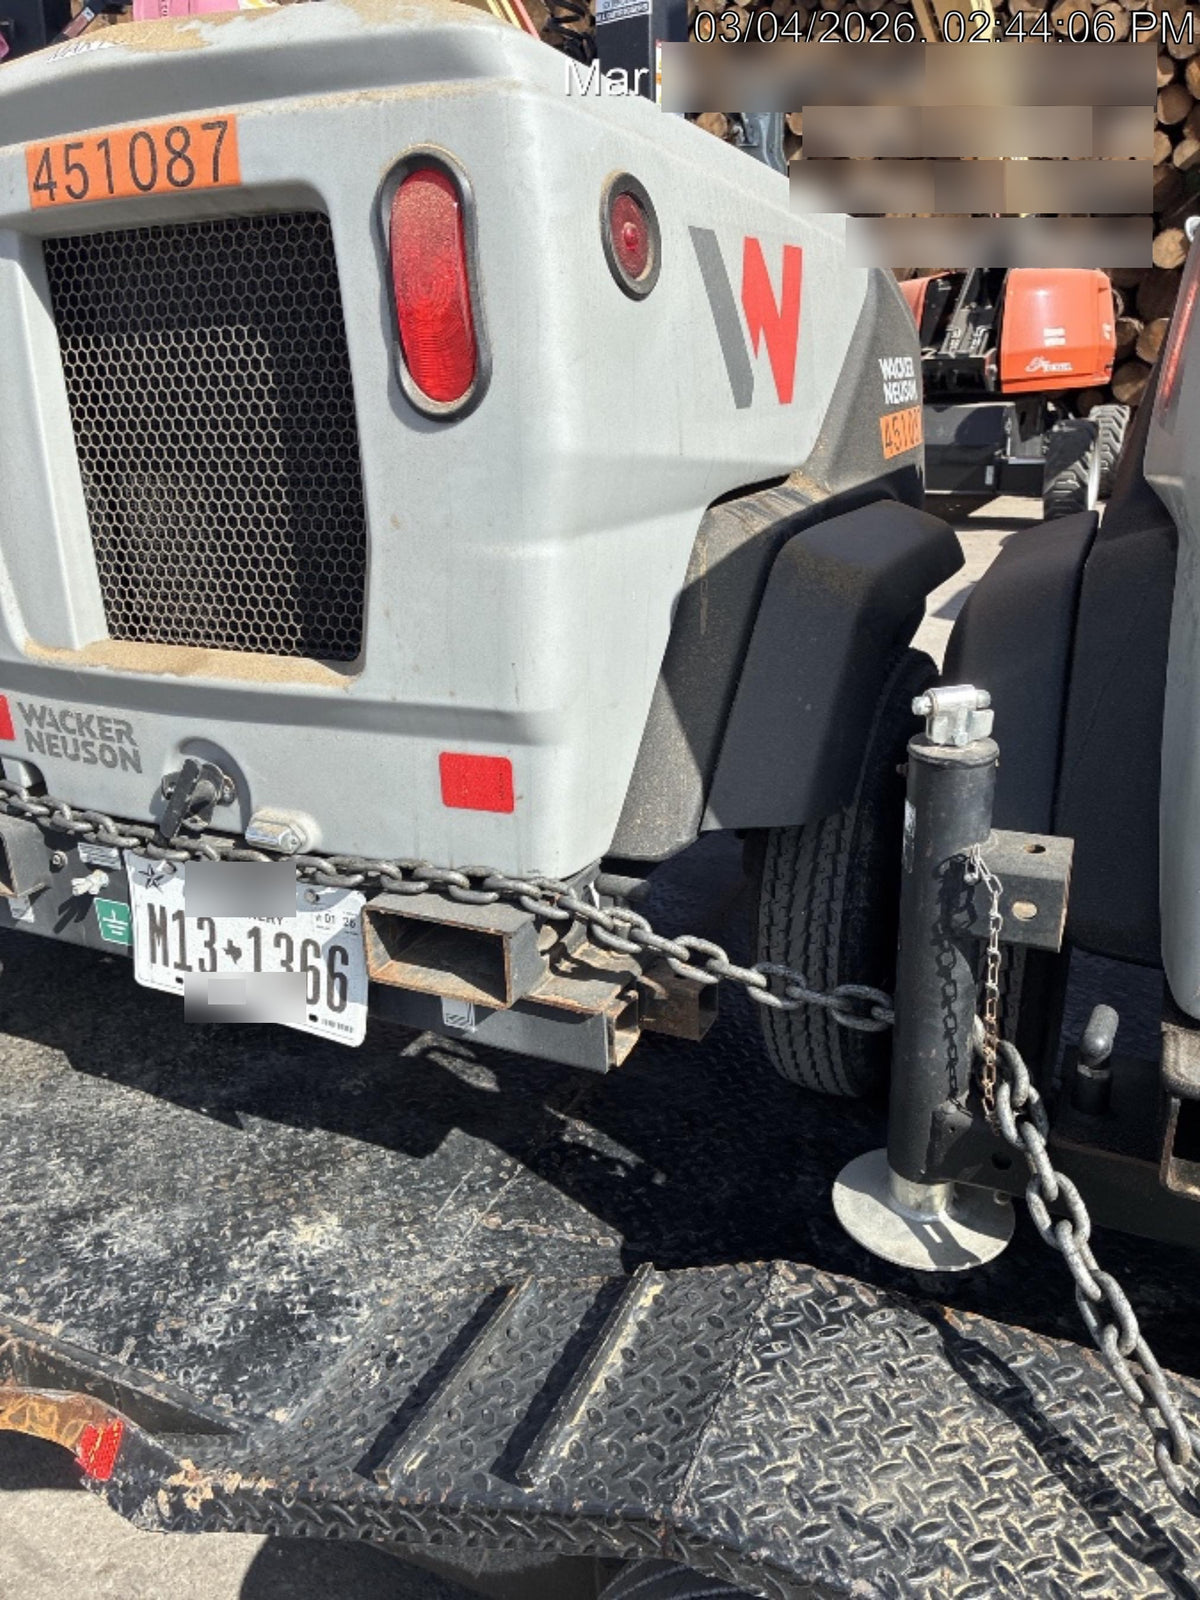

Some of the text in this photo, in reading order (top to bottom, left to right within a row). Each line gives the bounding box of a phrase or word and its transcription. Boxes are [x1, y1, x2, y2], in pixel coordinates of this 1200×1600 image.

[33, 120, 229, 202] 451087
[17, 702, 139, 747] WACKER
[24, 729, 143, 775] NEUSON
[147, 902, 218, 973] M13
